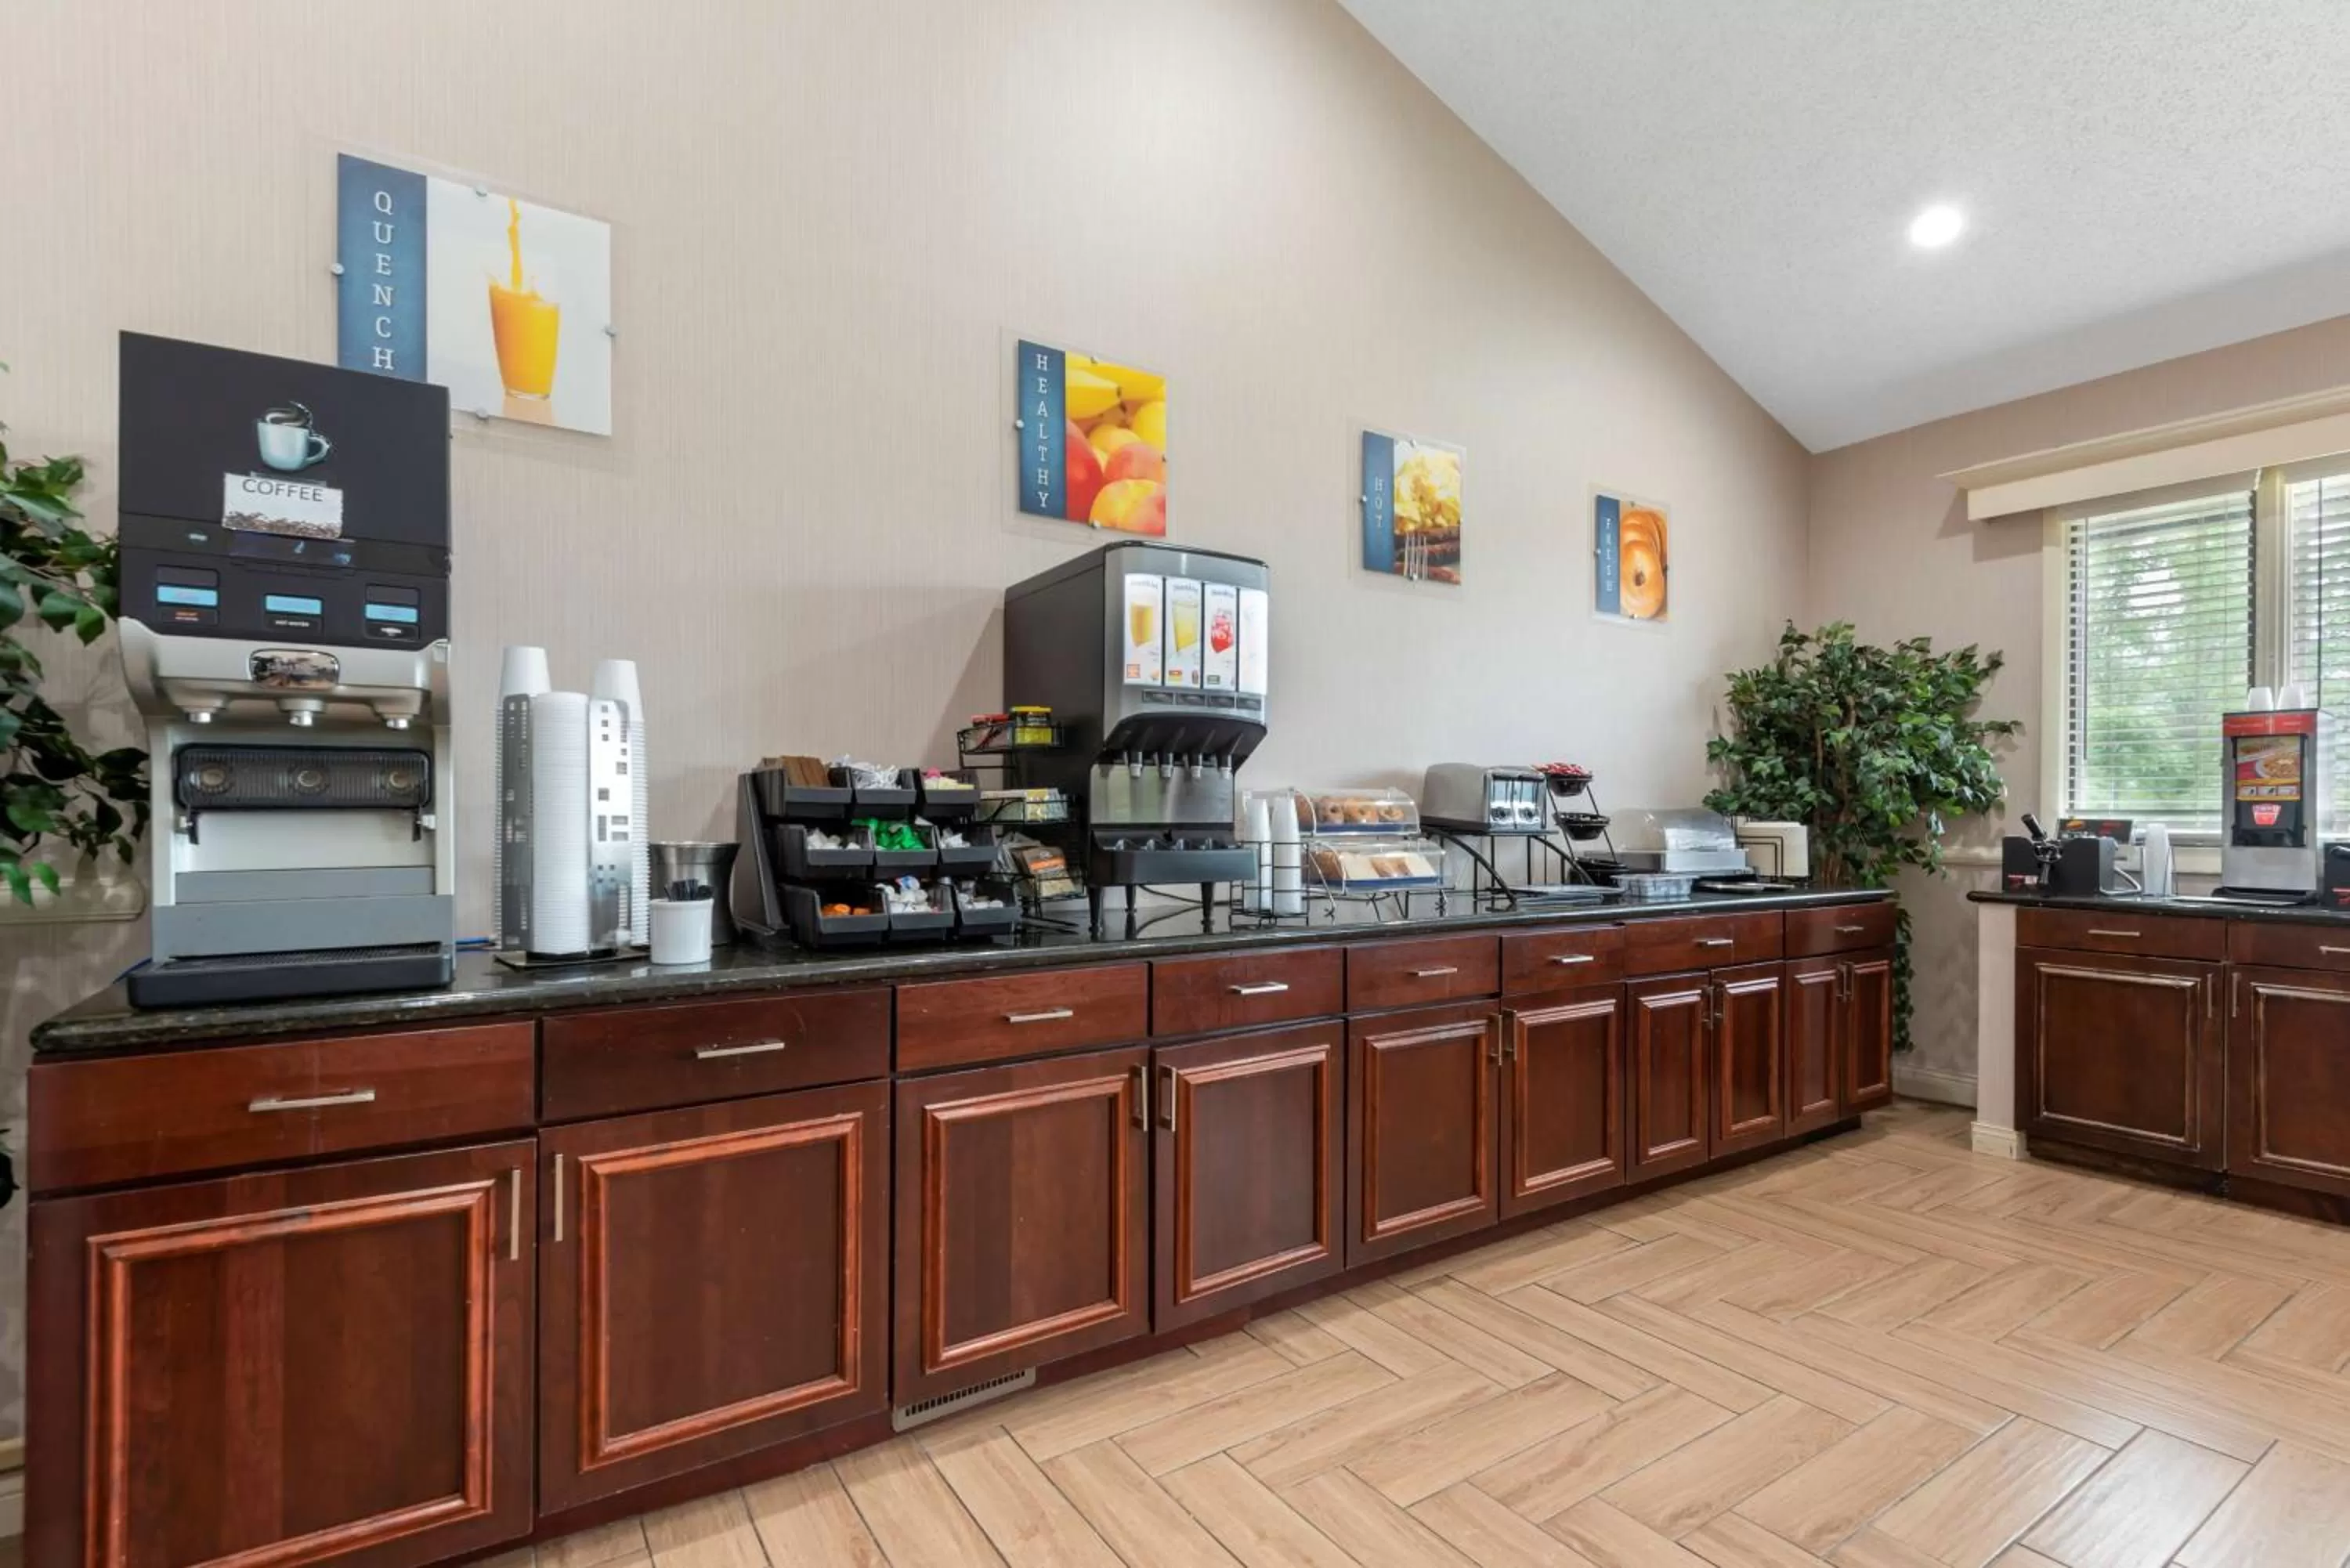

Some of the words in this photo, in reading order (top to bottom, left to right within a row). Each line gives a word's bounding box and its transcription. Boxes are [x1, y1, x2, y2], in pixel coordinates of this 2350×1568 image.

[372, 191, 395, 370] QUENCH
[242, 479, 324, 502] COFFEE
[1036, 354, 1049, 508] HEALTHY
